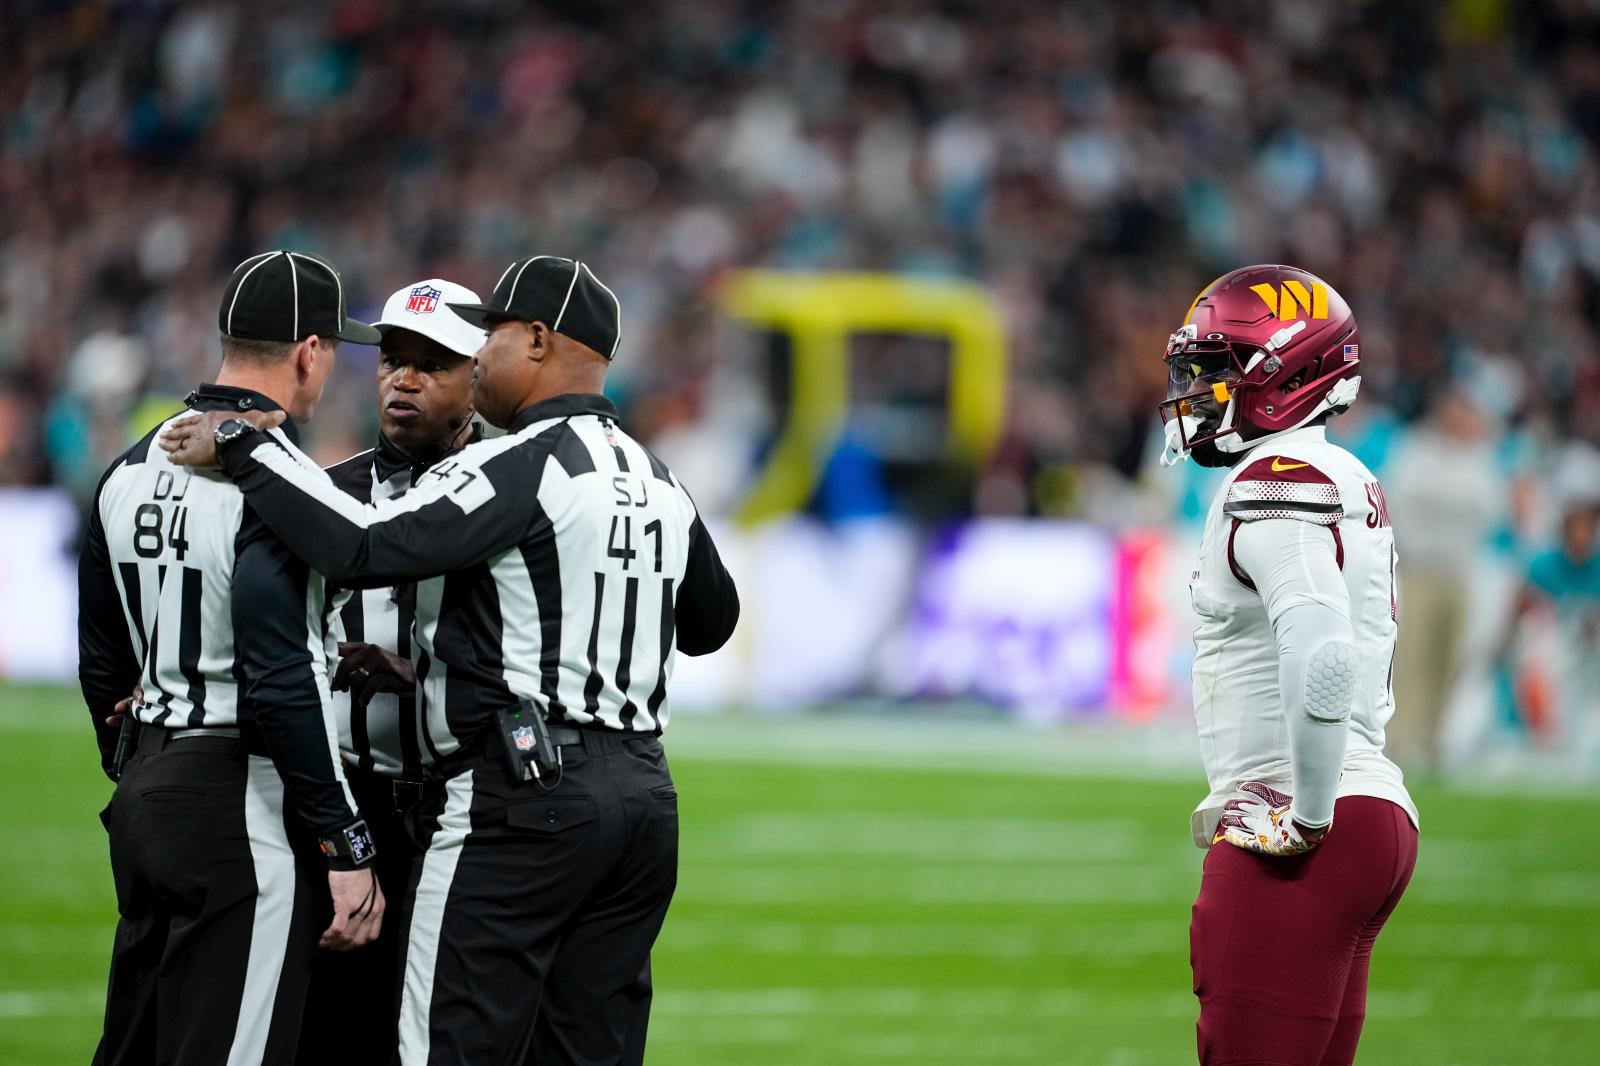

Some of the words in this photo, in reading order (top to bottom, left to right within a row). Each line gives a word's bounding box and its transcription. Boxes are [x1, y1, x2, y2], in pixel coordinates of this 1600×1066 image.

[408, 296, 433, 312] NFL
[153, 471, 191, 501] DJ
[613, 477, 648, 507] SJ
[133, 504, 189, 561] 84
[607, 515, 662, 572] 41
